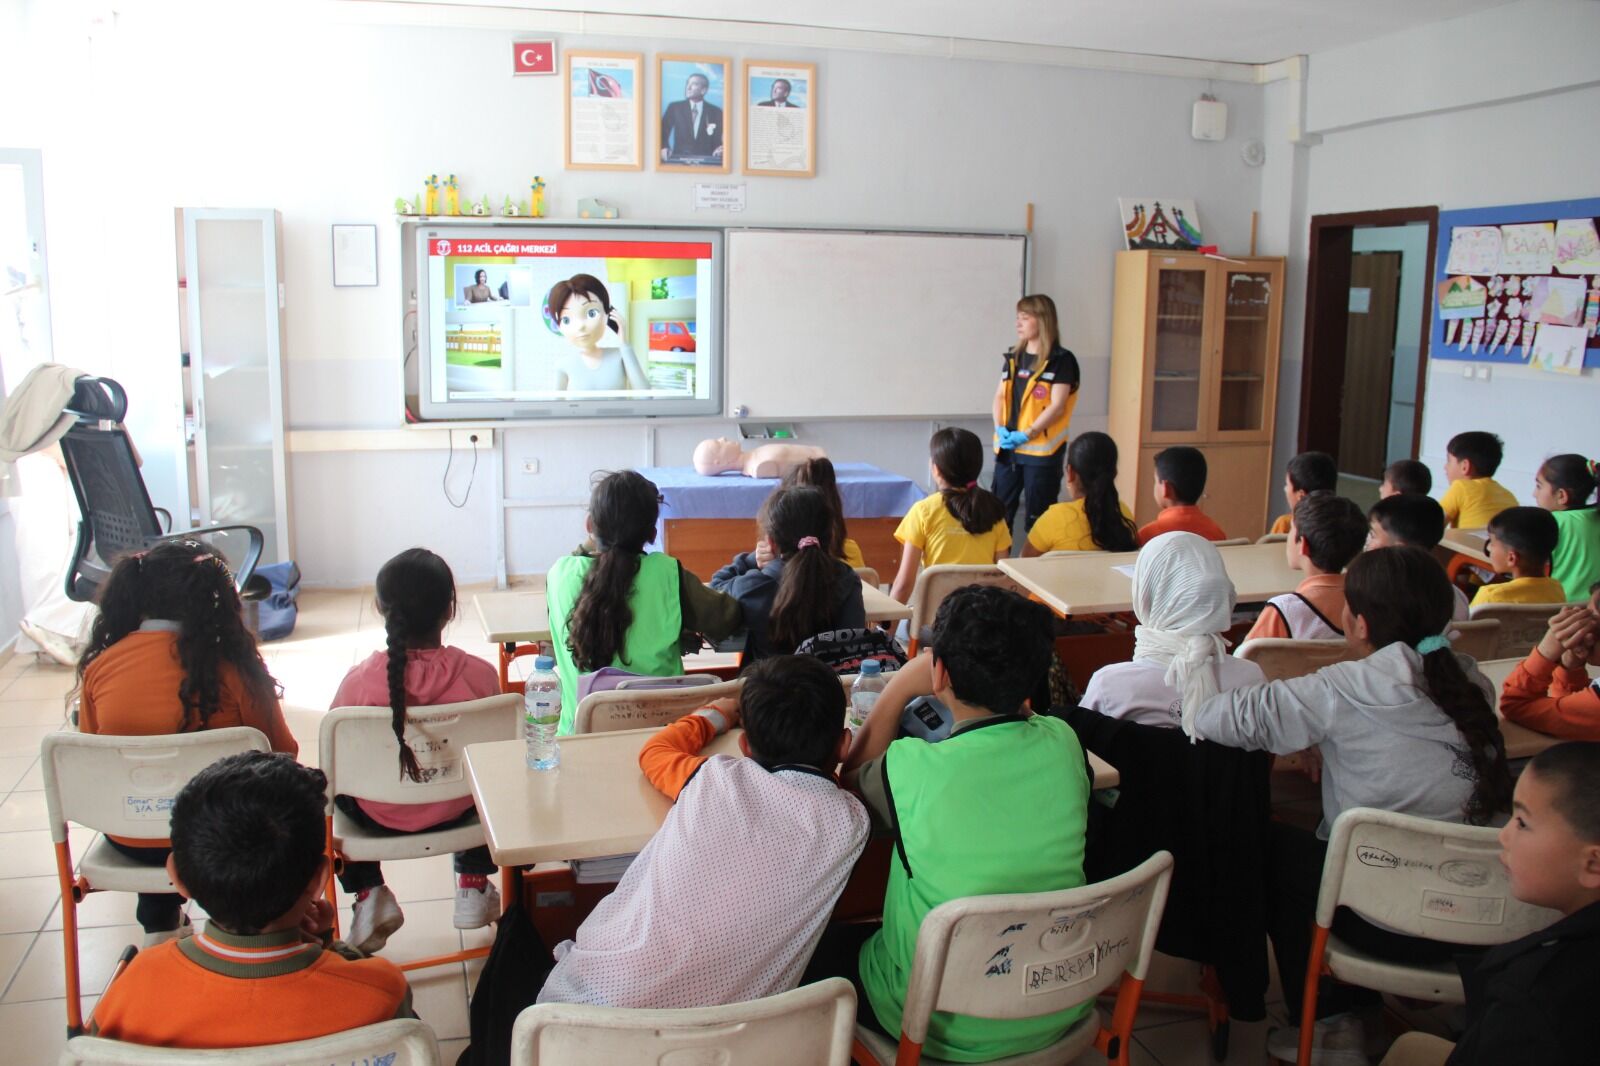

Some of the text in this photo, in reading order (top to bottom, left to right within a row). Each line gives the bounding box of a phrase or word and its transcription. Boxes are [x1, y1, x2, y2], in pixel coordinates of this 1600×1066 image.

[457, 242, 556, 255] 112 ACİL ÇAĞRI MERKEZİ
